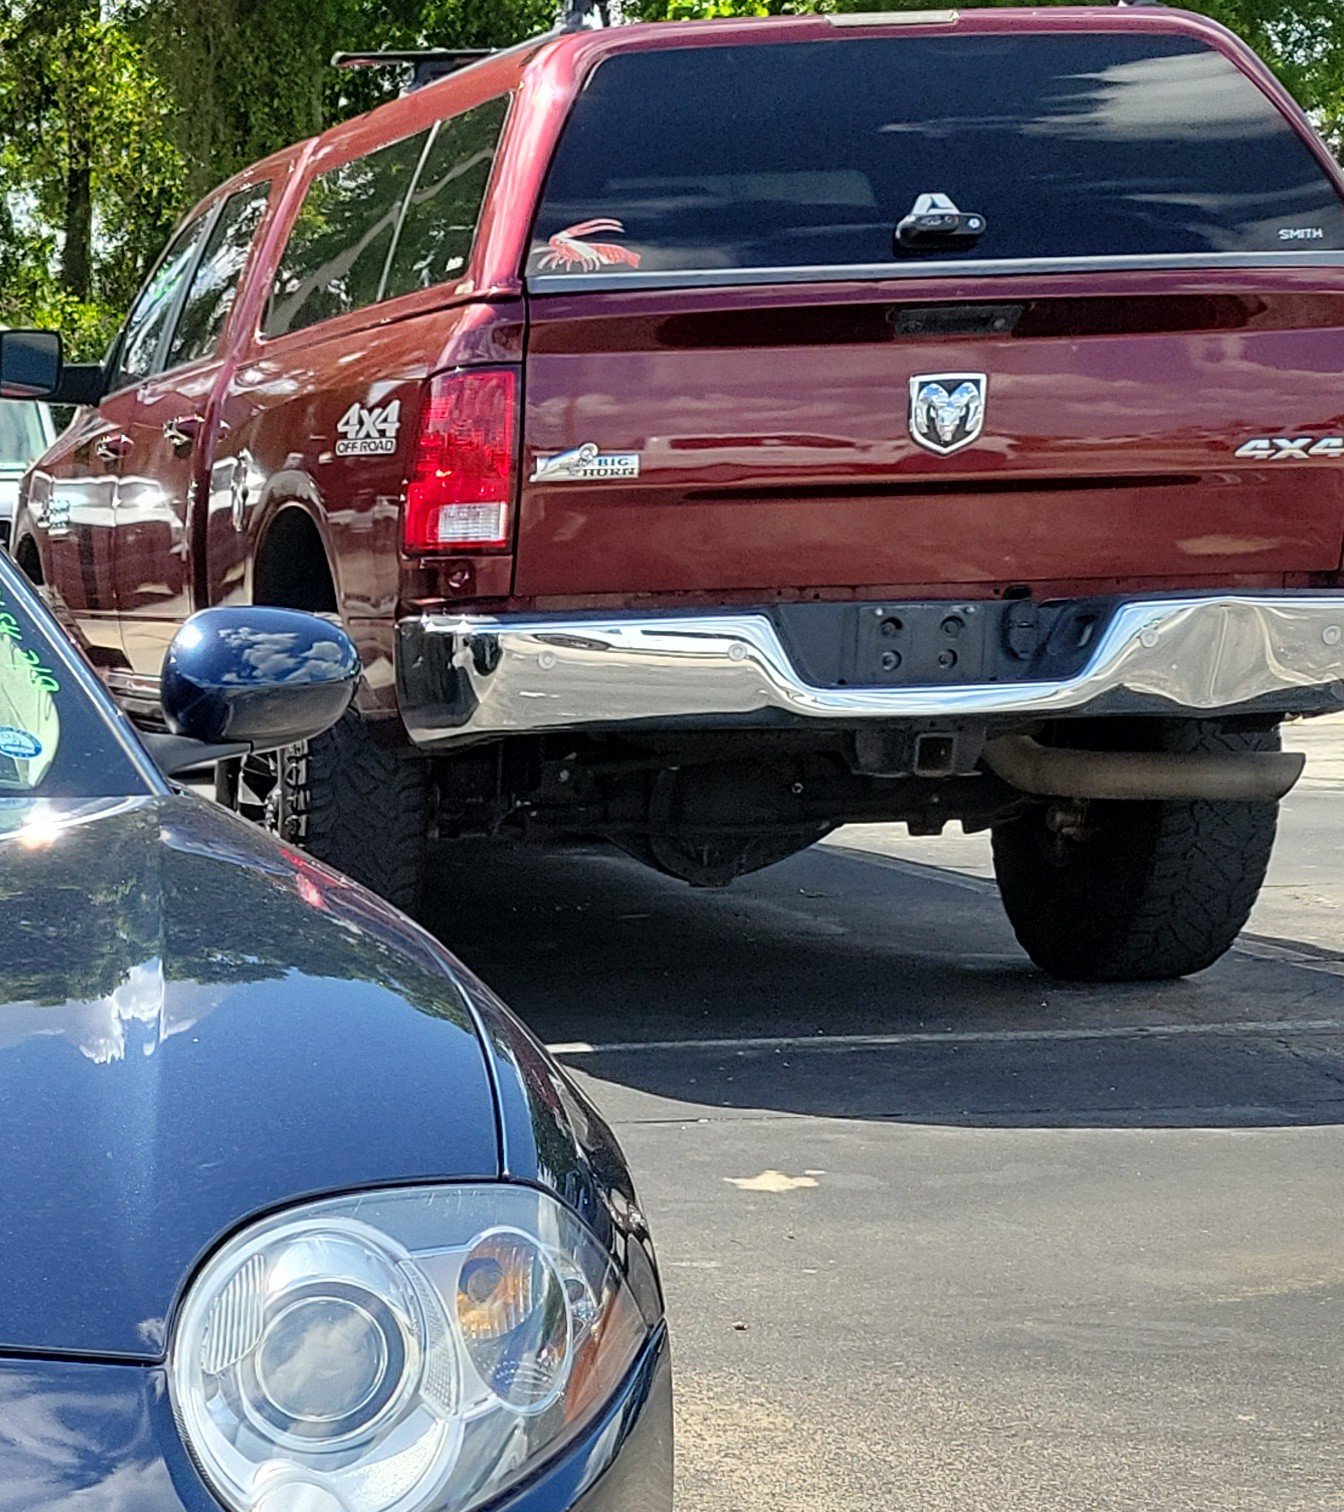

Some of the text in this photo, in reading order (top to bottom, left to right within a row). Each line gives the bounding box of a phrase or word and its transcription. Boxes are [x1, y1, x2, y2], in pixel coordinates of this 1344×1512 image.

[1278, 228, 1323, 240] SMITH
[337, 440, 394, 454] OFF ROAD
[597, 458, 629, 467] BIG
[582, 467, 638, 477] HORN
